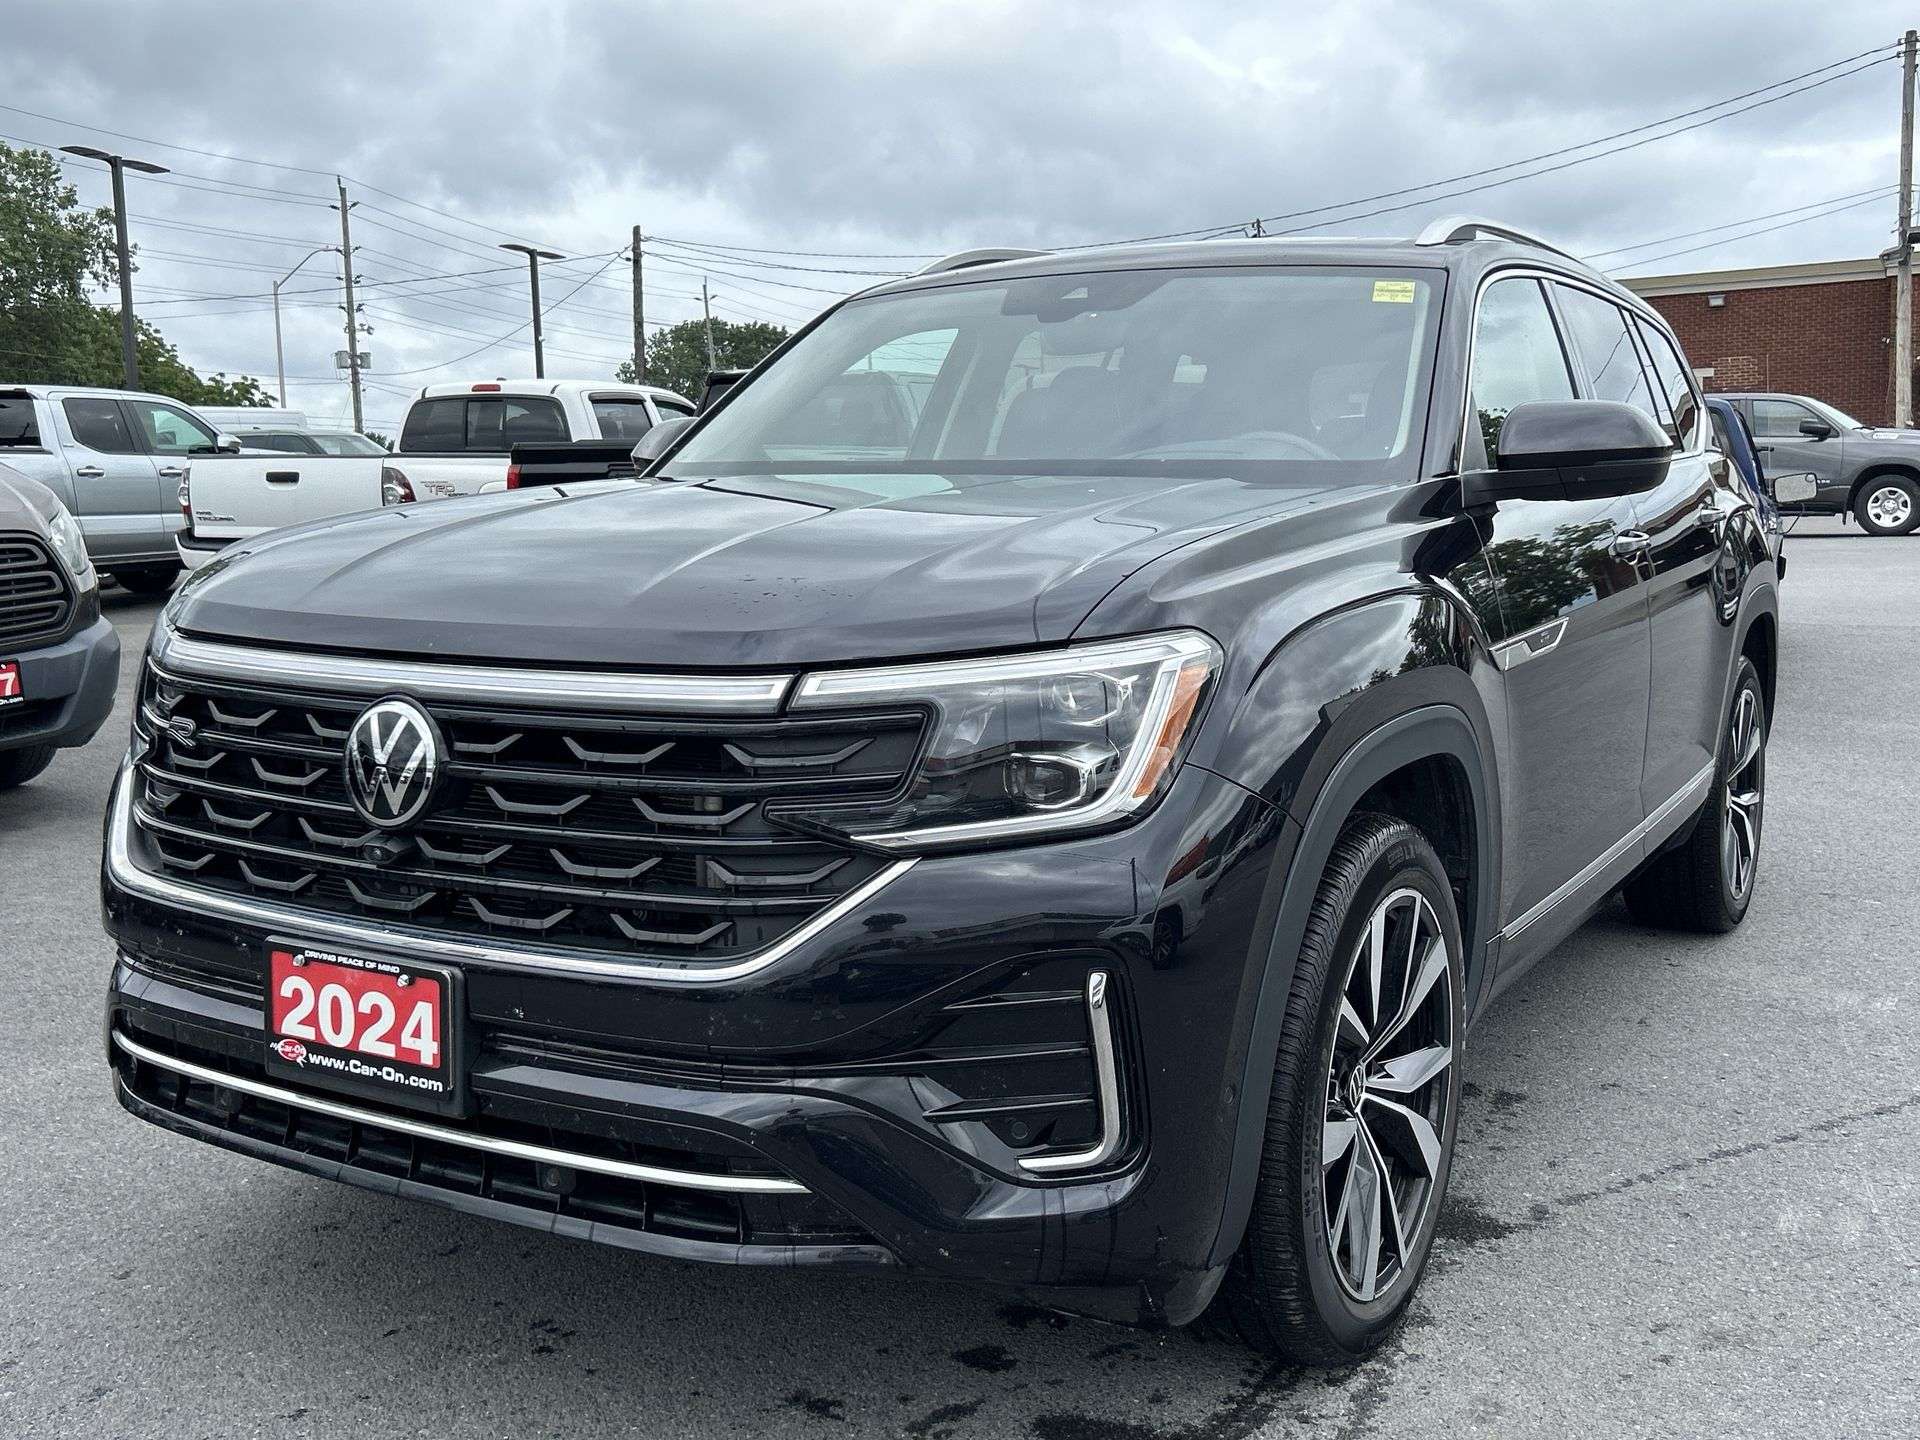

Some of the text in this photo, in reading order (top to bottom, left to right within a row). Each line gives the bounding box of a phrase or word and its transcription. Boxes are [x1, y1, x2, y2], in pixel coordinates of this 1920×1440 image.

[304, 949, 400, 974] DRIVING PEACE OF MIND
[280, 975, 439, 1066] 2024
[308, 1052, 443, 1093] www.Car-On.com
